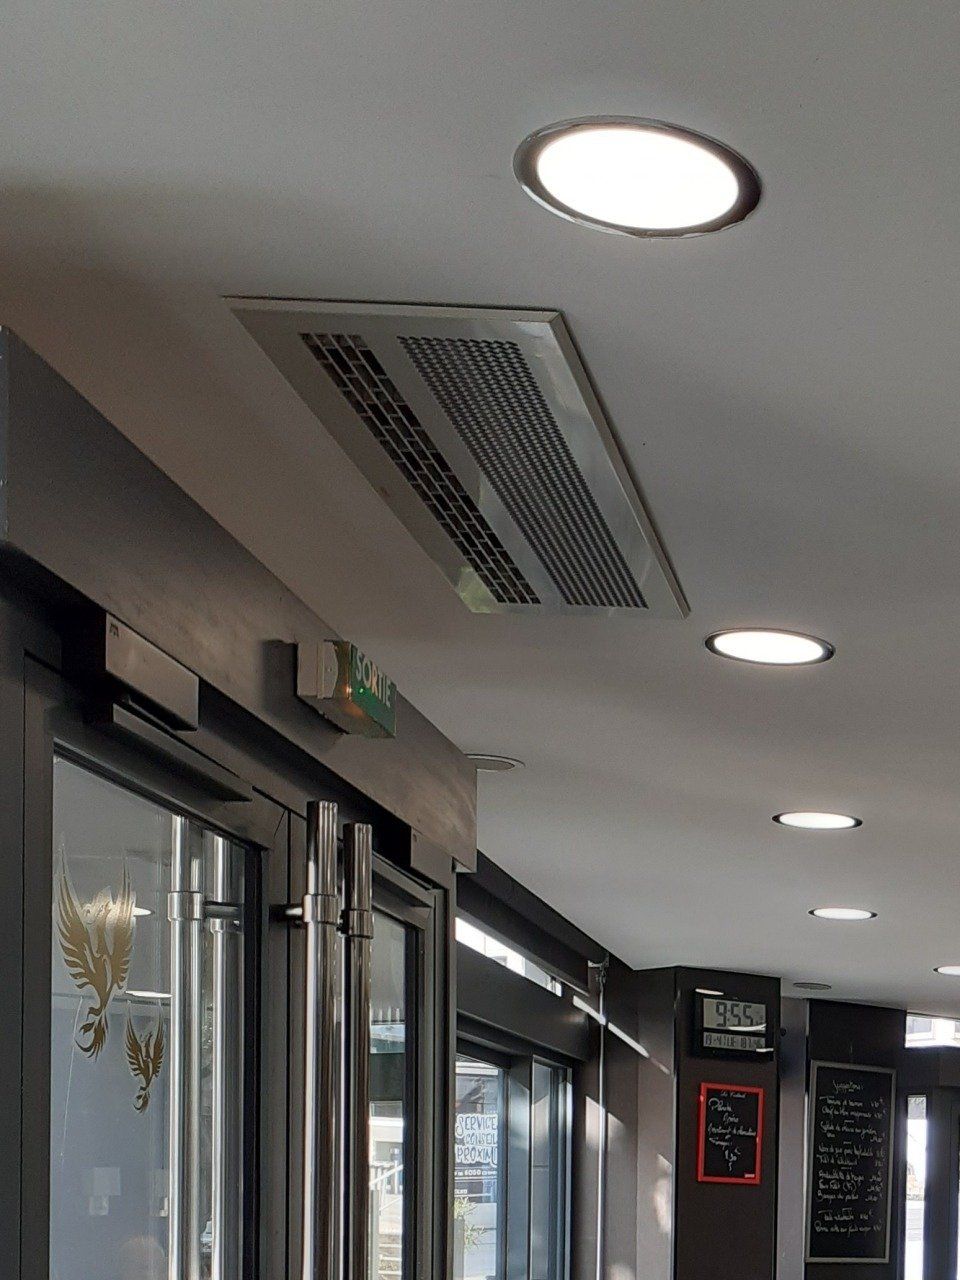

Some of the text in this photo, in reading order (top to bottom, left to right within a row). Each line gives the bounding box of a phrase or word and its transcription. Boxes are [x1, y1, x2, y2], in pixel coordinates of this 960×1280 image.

[355, 647, 392, 709] SORTIE
[716, 1001, 754, 1027] 9:55
[455, 1116, 497, 1137] SERVICE
